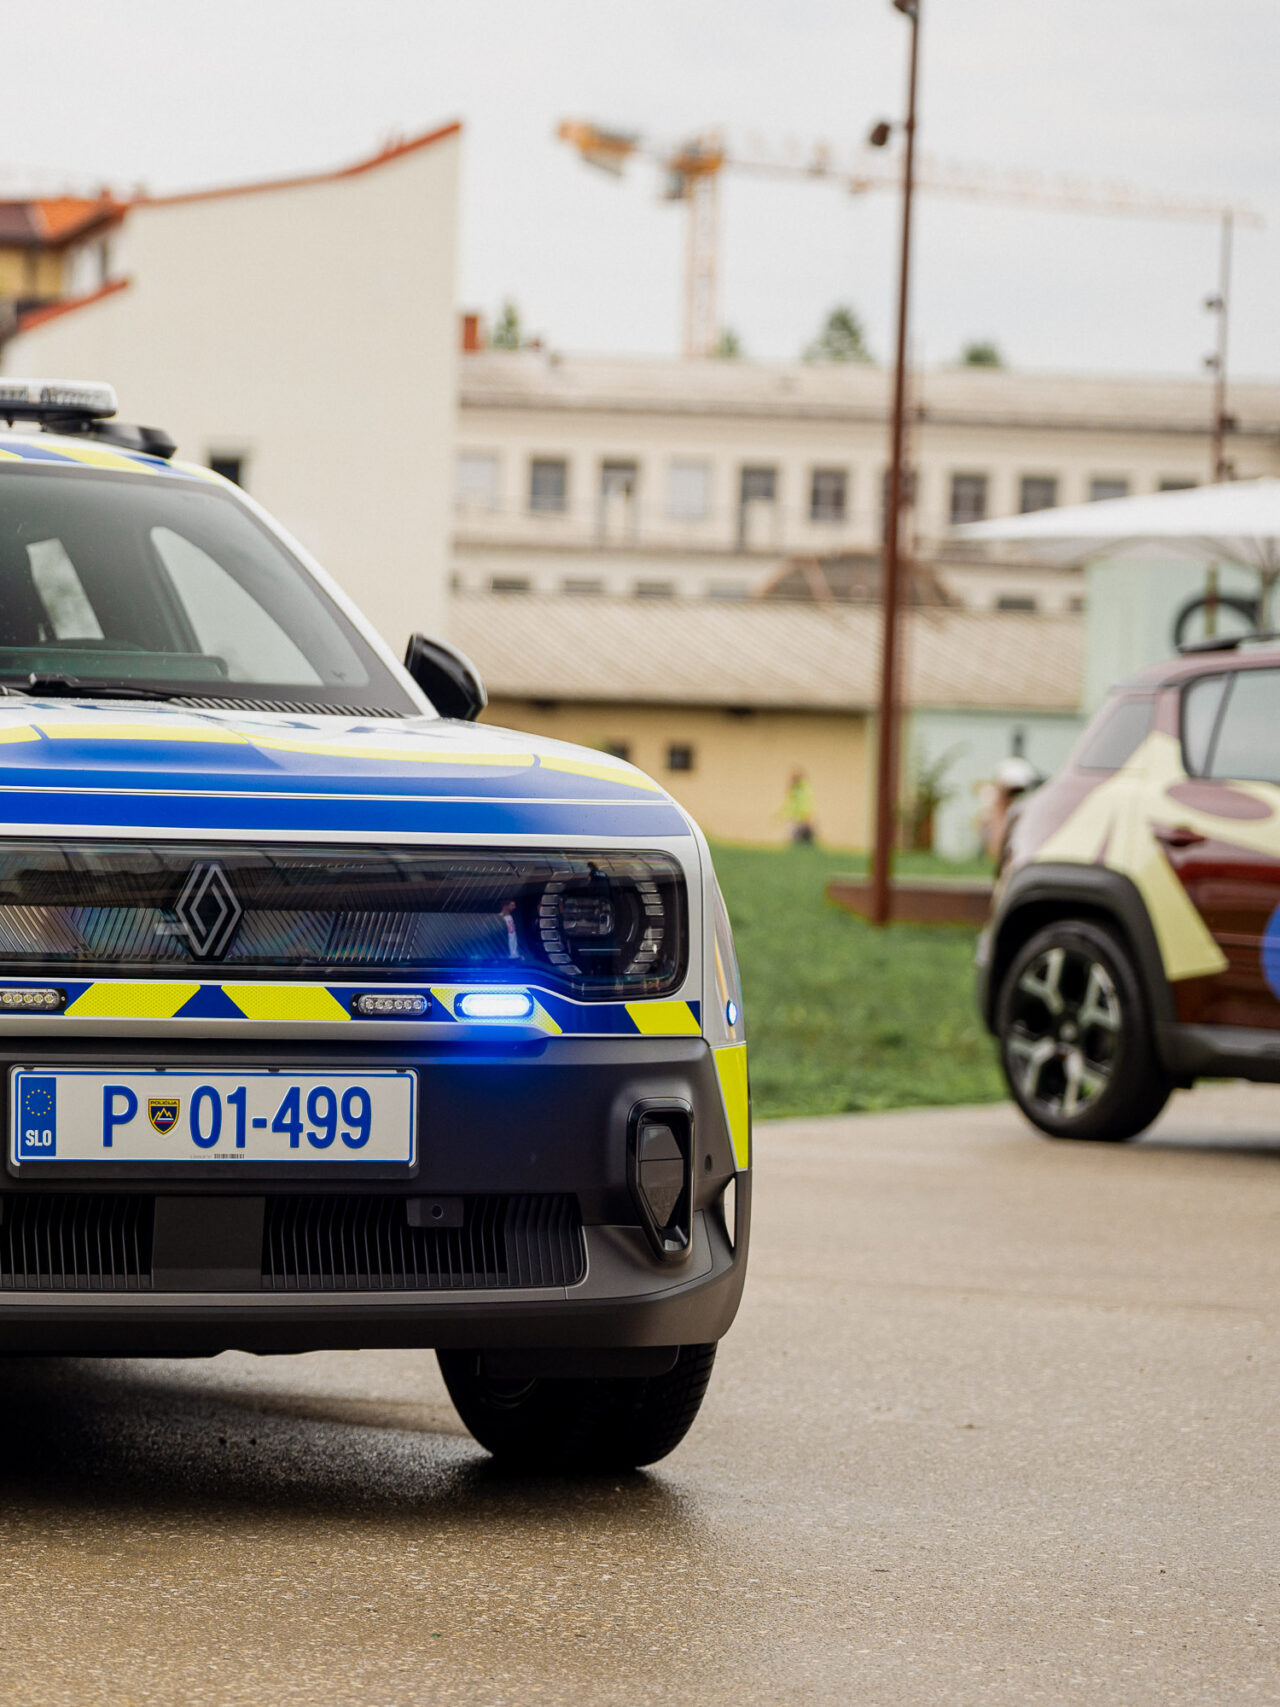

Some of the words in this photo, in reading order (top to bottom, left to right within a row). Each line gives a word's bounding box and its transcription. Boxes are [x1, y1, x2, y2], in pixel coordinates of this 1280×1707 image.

[102, 1084, 138, 1147] P
[189, 1084, 372, 1149] 01-499
[25, 1129, 52, 1146] SLO
